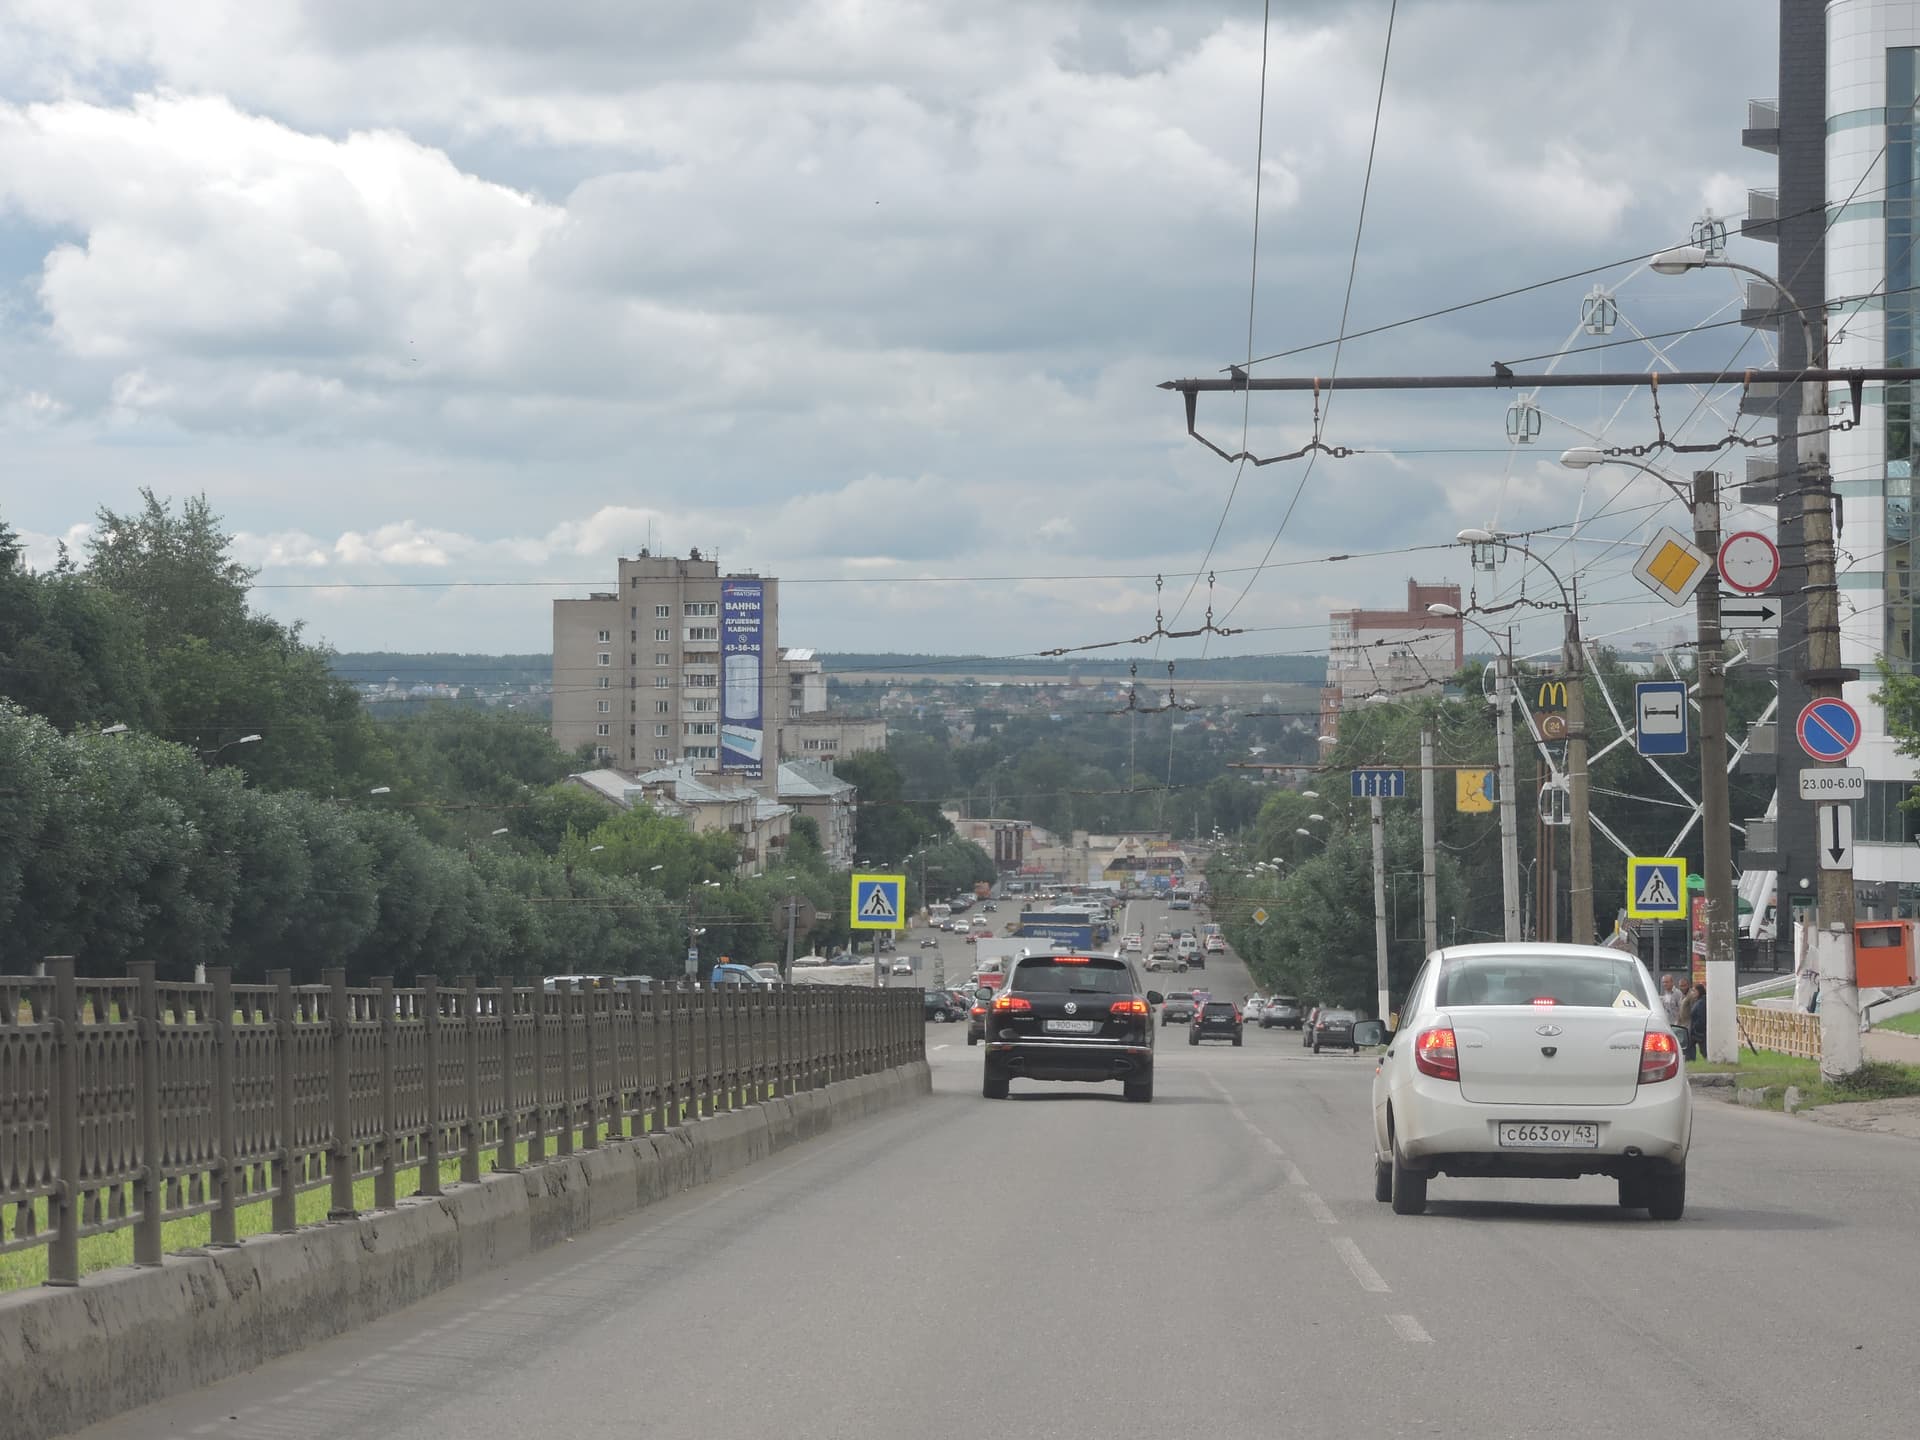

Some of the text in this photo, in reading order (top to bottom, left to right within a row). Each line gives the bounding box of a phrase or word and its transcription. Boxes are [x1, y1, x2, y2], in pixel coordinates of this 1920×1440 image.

[725, 602, 760, 610] ВАННЫ
[1802, 778, 1862, 789] 23.00-6.00
[1575, 1126, 1592, 1138] 43
